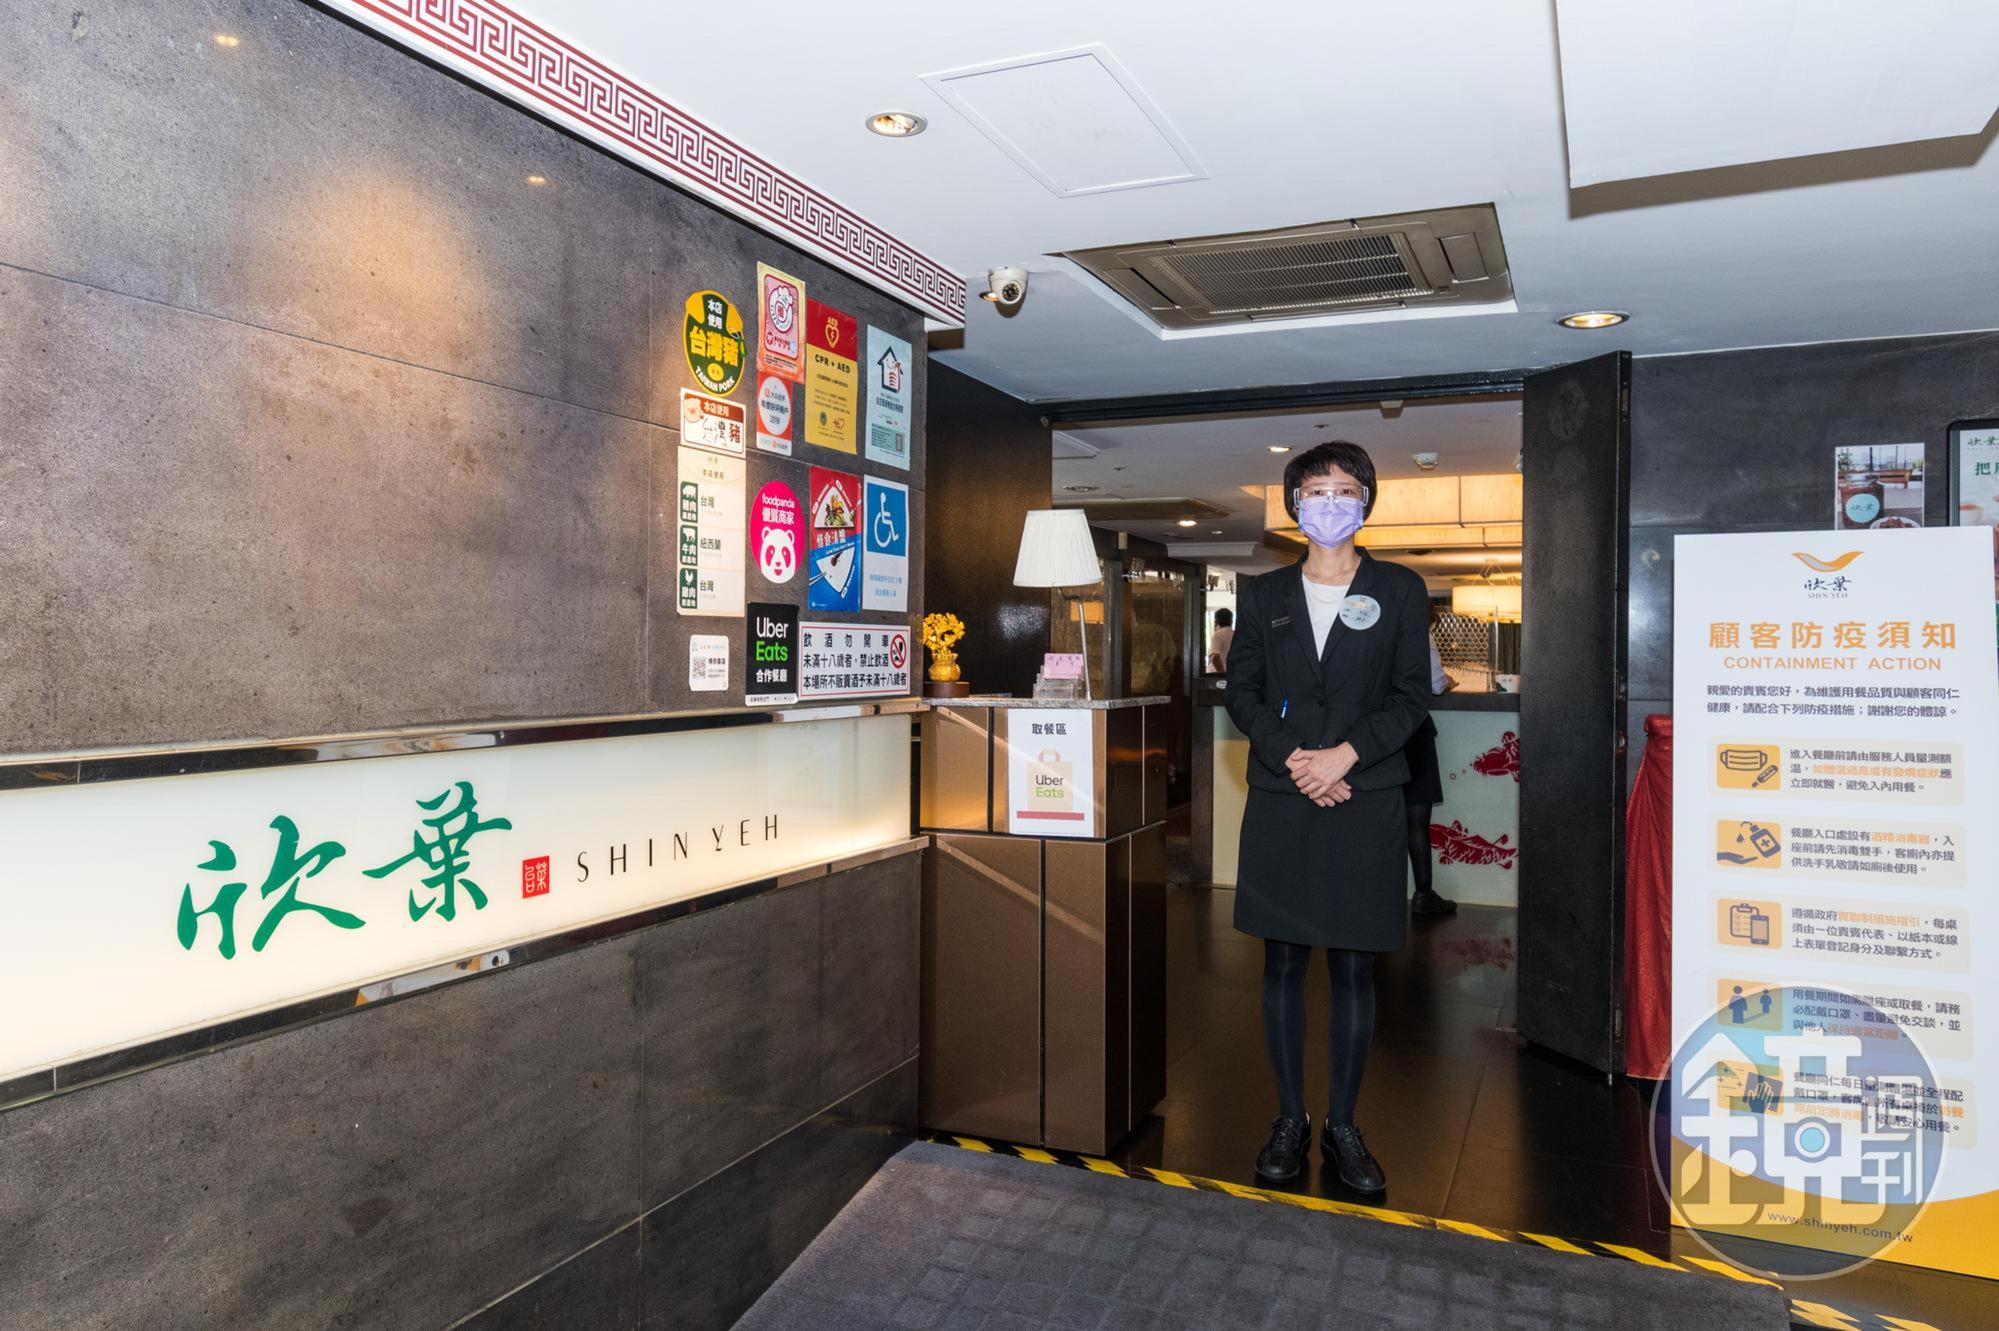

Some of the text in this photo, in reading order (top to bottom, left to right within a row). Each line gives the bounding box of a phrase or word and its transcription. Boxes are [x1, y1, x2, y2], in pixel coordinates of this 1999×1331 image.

[690, 325, 739, 368] 台灣豬
[814, 354, 830, 367] CPR
[837, 363, 850, 374] AED
[696, 365, 719, 392] TAIWAN
[762, 493, 795, 508] foodpanda
[1804, 576, 1852, 592] 欣葉
[756, 617, 788, 638] Uber
[1708, 620, 1956, 650] 顧客防疫須知
[804, 632, 889, 648] 飲酒勿開車
[756, 640, 788, 662] Eats
[1724, 656, 1942, 670] CONTAINMENT ACTION
[1032, 723, 1066, 736] 取餐區
[1036, 774, 1064, 786] Uber
[1036, 787, 1064, 798] Eats
[578, 813, 779, 883] SHIN YEH
[177, 781, 512, 960] 欣葉
[1768, 1211, 1913, 1243] www.shinyeh.com.tw
